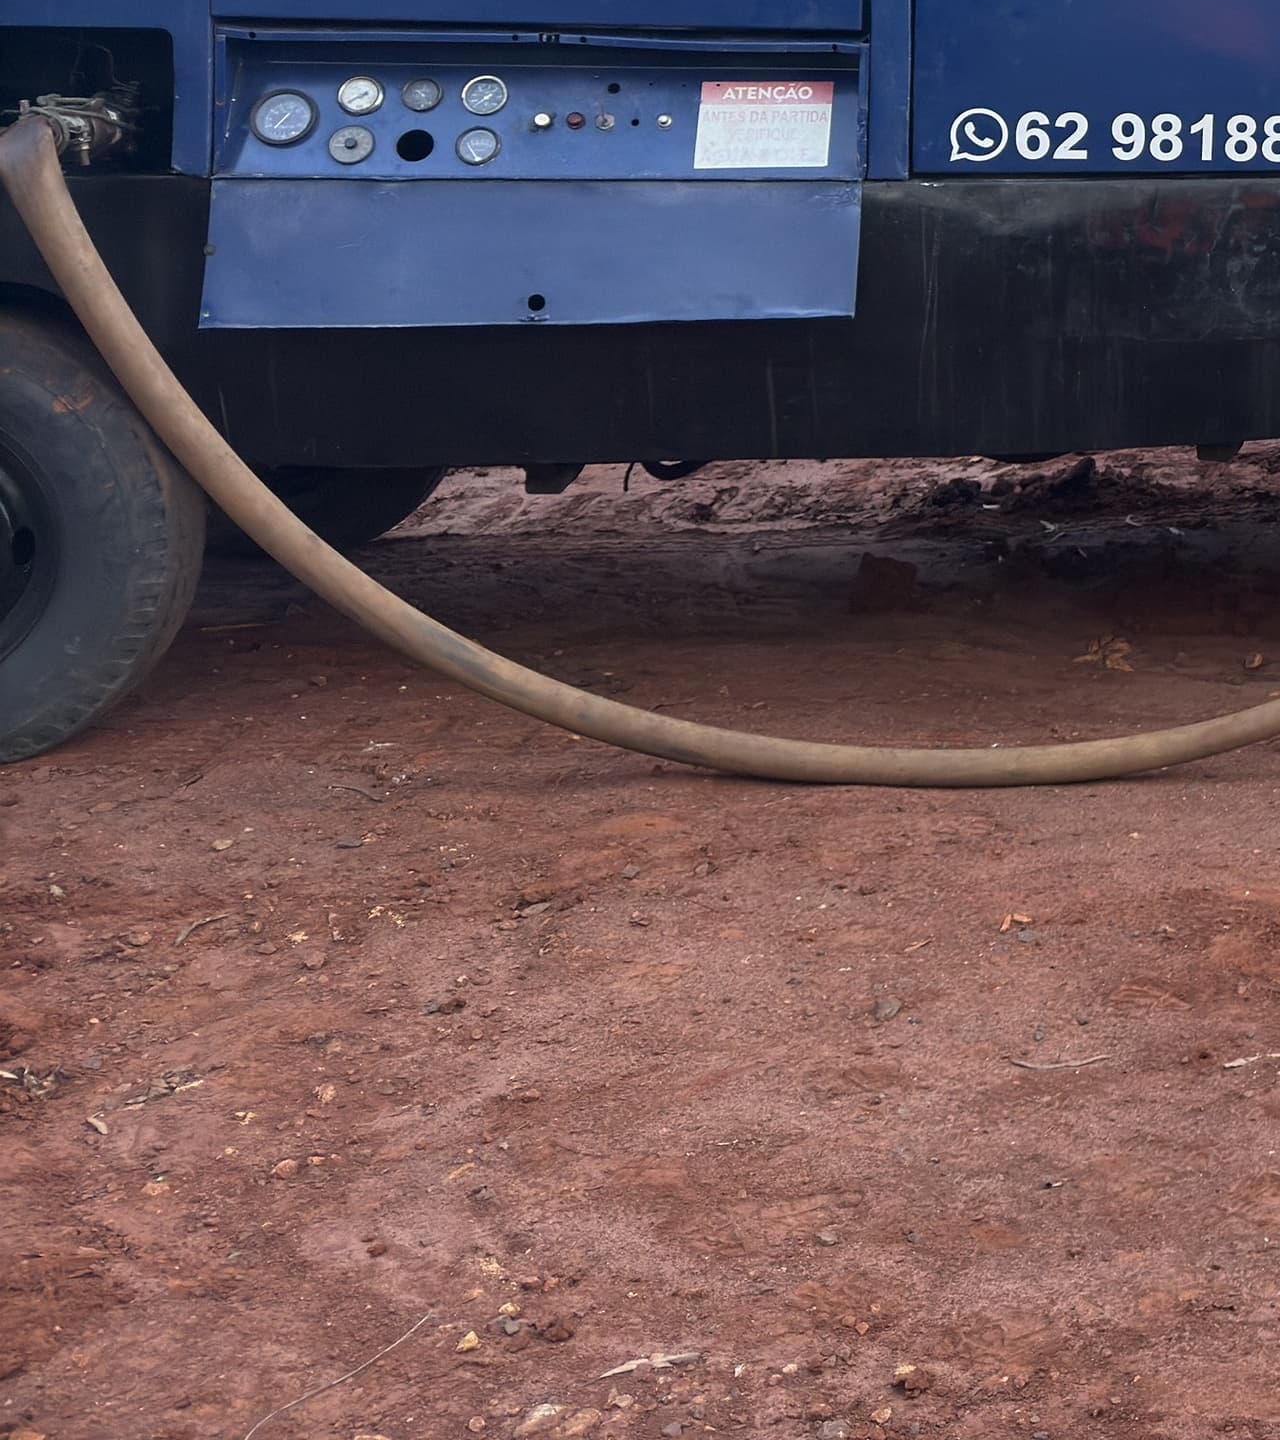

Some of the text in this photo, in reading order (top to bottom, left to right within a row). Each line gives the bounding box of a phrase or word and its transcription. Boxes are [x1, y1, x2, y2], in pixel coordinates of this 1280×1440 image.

[722, 83, 813, 103] ATENÇÃO
[703, 111, 828, 123] ANTES DA PARTIDA
[1015, 111, 1089, 160] 62
